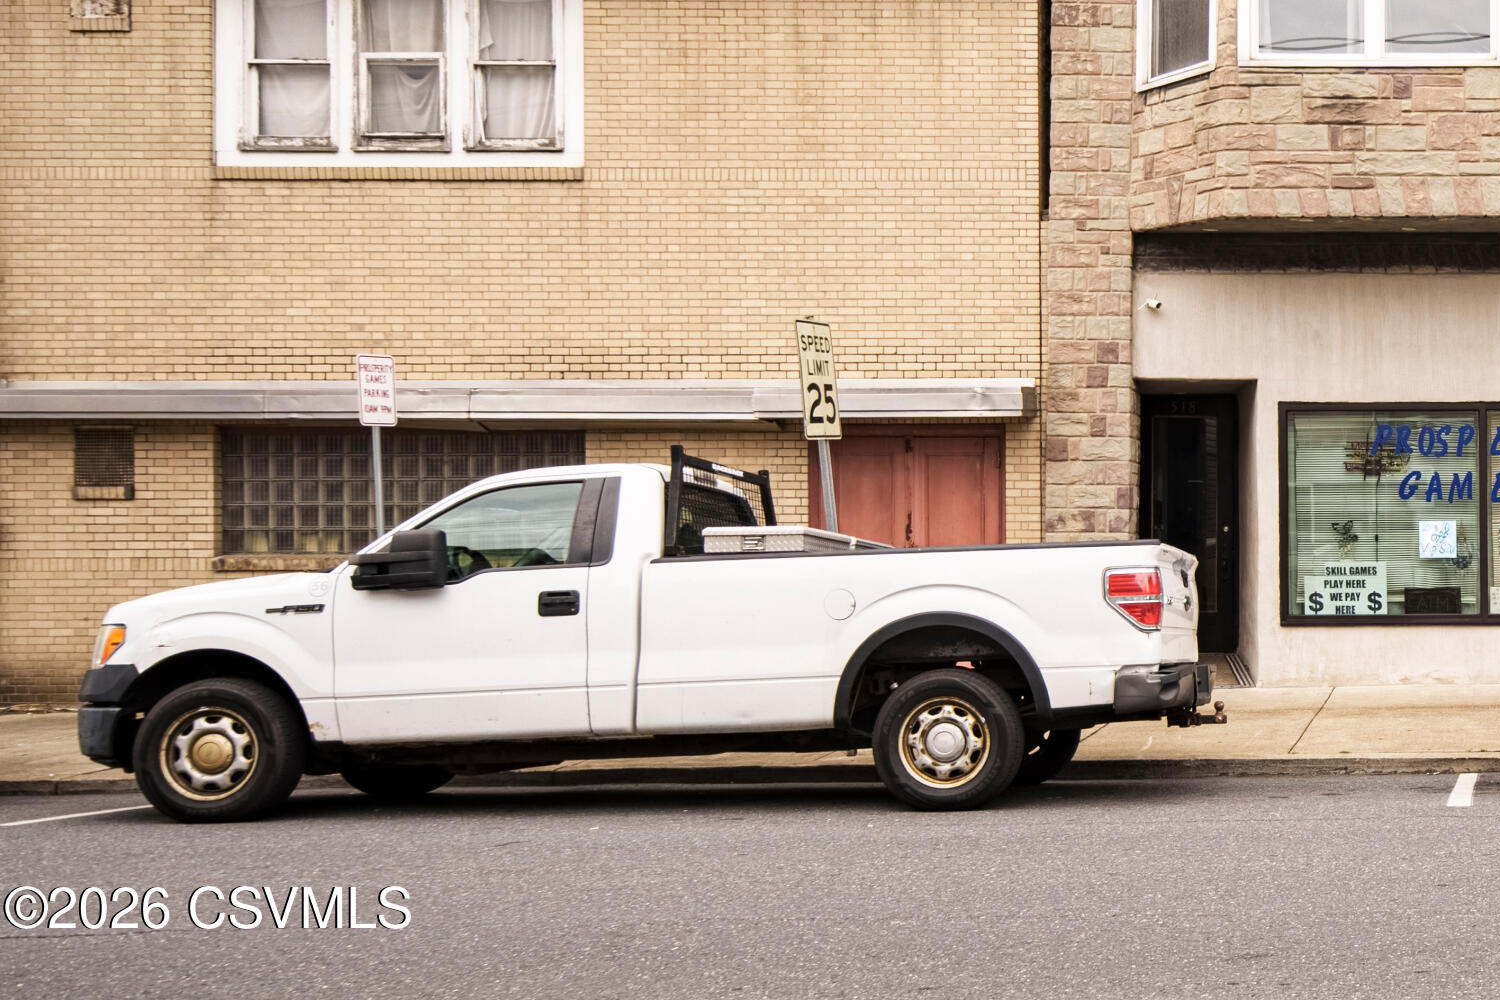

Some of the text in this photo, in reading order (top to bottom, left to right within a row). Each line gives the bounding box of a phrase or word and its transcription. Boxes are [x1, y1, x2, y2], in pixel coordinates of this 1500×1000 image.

[800, 334, 831, 354] SPEED
[807, 359, 830, 376] LIMIT
[807, 382, 837, 425] 25
[1325, 566, 1378, 576] SKILL GAMES
[1324, 580, 1367, 589] PLAY HERE
[1330, 592, 1361, 602] WE PAY
[1335, 605, 1356, 615] HERE
